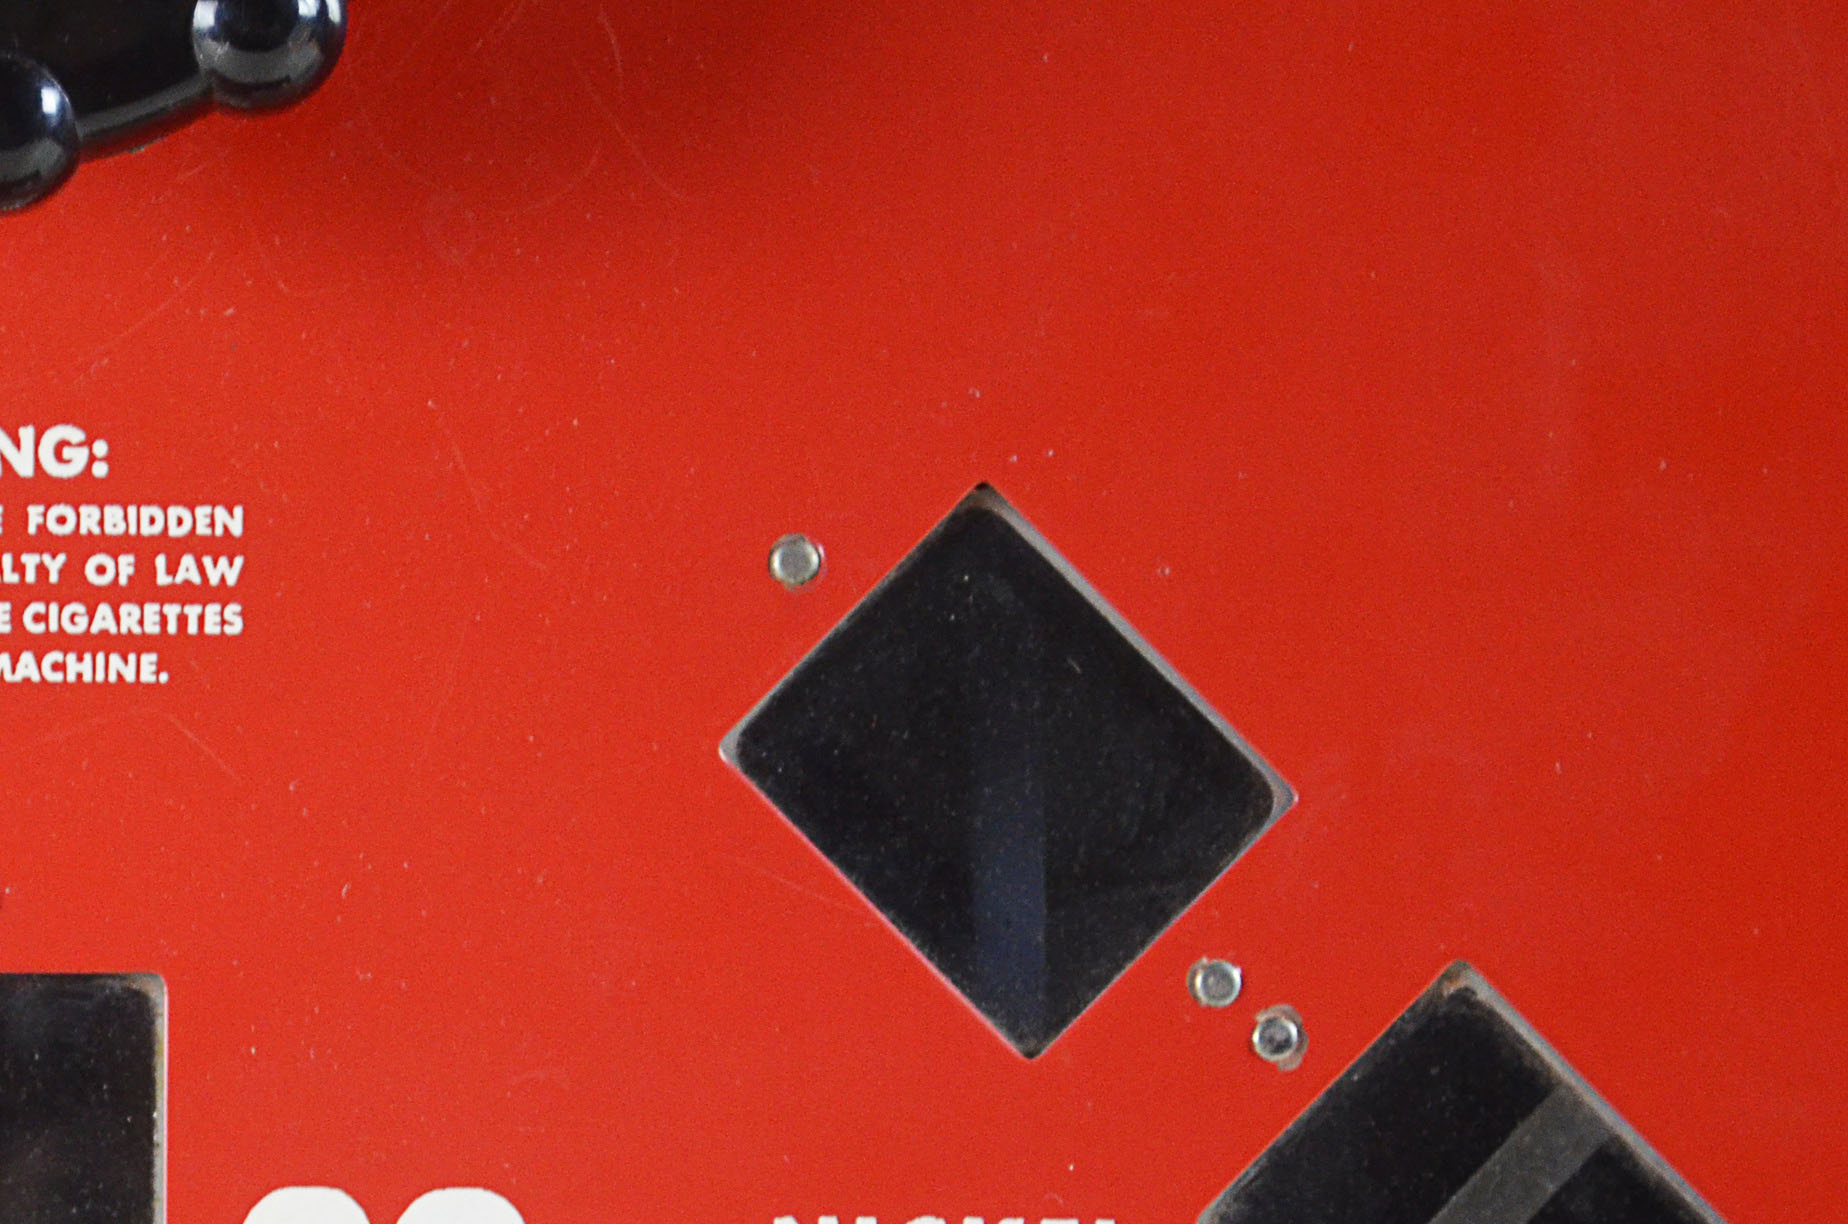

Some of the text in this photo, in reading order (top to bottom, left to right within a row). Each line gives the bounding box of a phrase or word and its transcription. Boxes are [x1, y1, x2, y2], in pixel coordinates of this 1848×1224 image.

[27, 503, 244, 538] FORBIDDEN
[84, 553, 136, 587] OF
[155, 553, 244, 587] LAW
[22, 601, 244, 636] CIGARETTES
